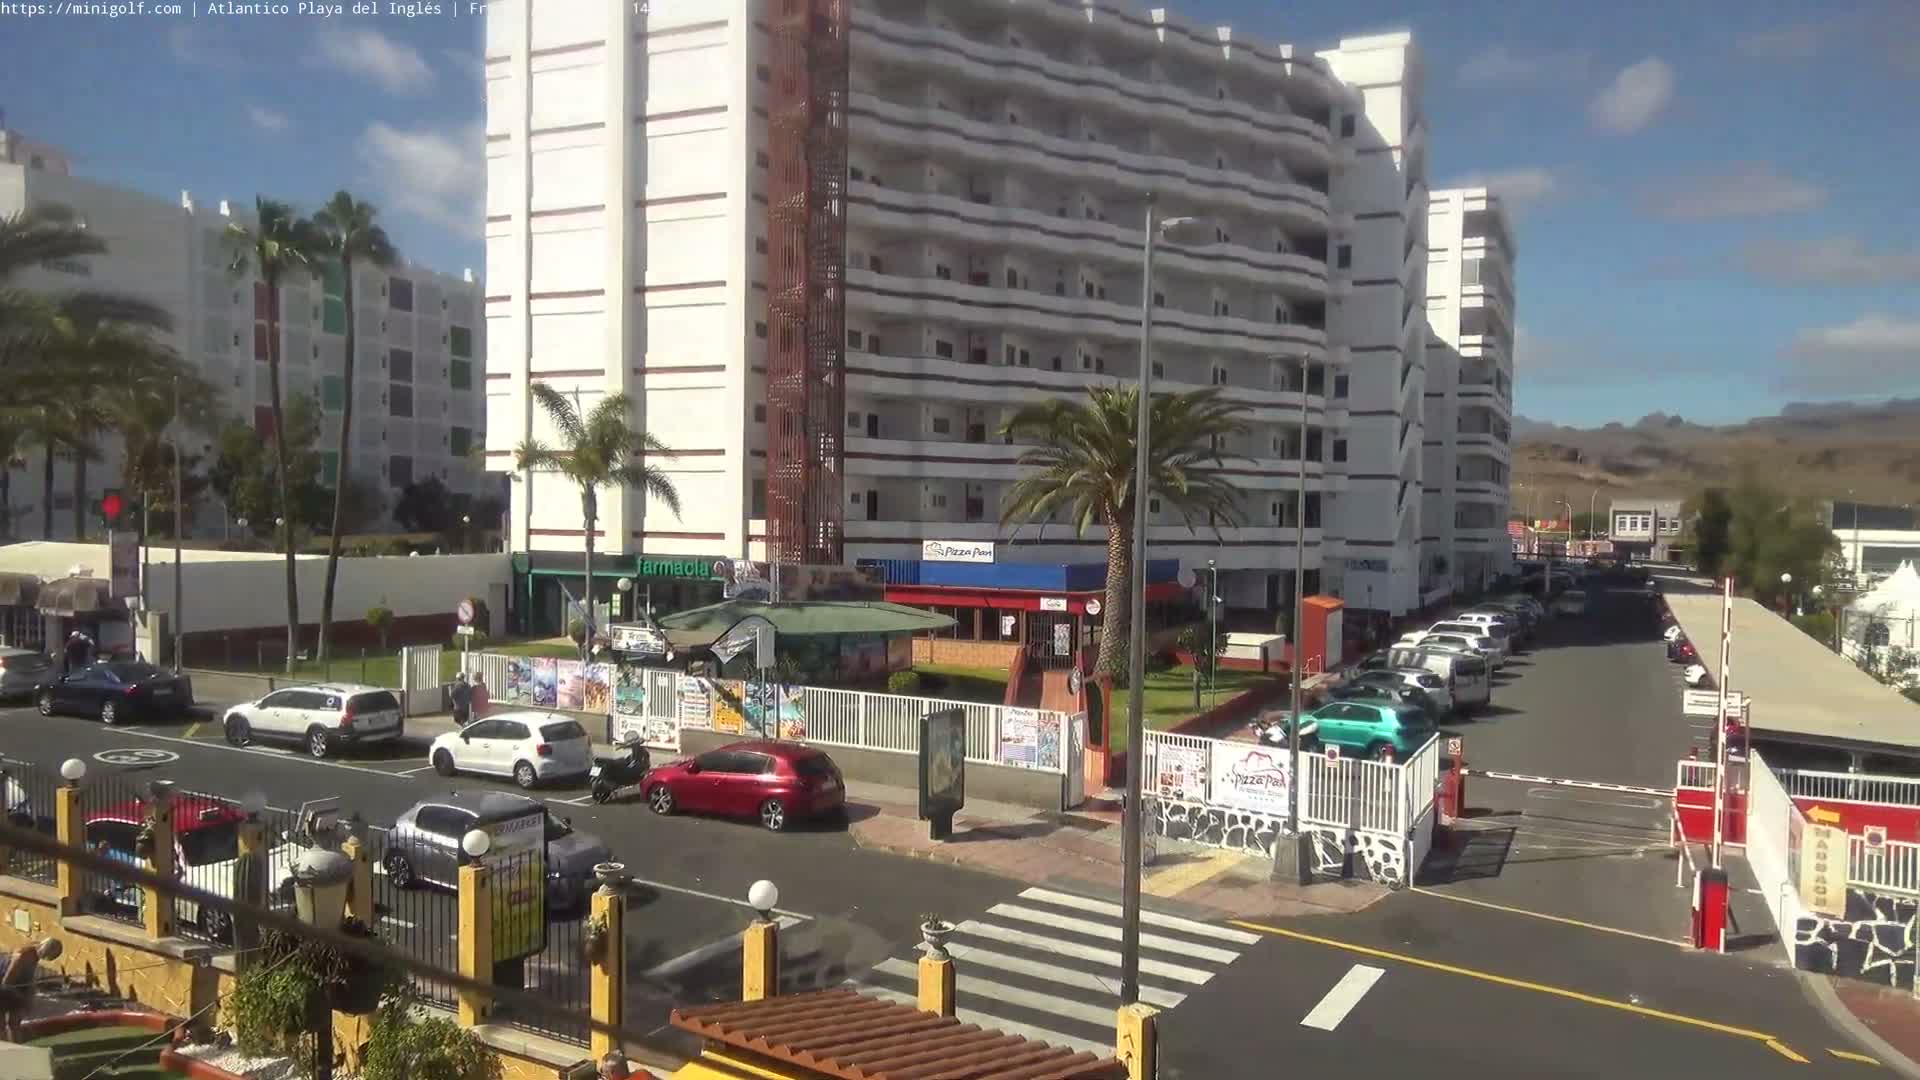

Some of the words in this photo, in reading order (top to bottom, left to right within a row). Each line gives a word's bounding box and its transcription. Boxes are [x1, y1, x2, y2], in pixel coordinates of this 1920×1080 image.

[944, 547, 971, 557] Pizza
[972, 547, 992, 558] Pan
[638, 558, 709, 577] farmacia
